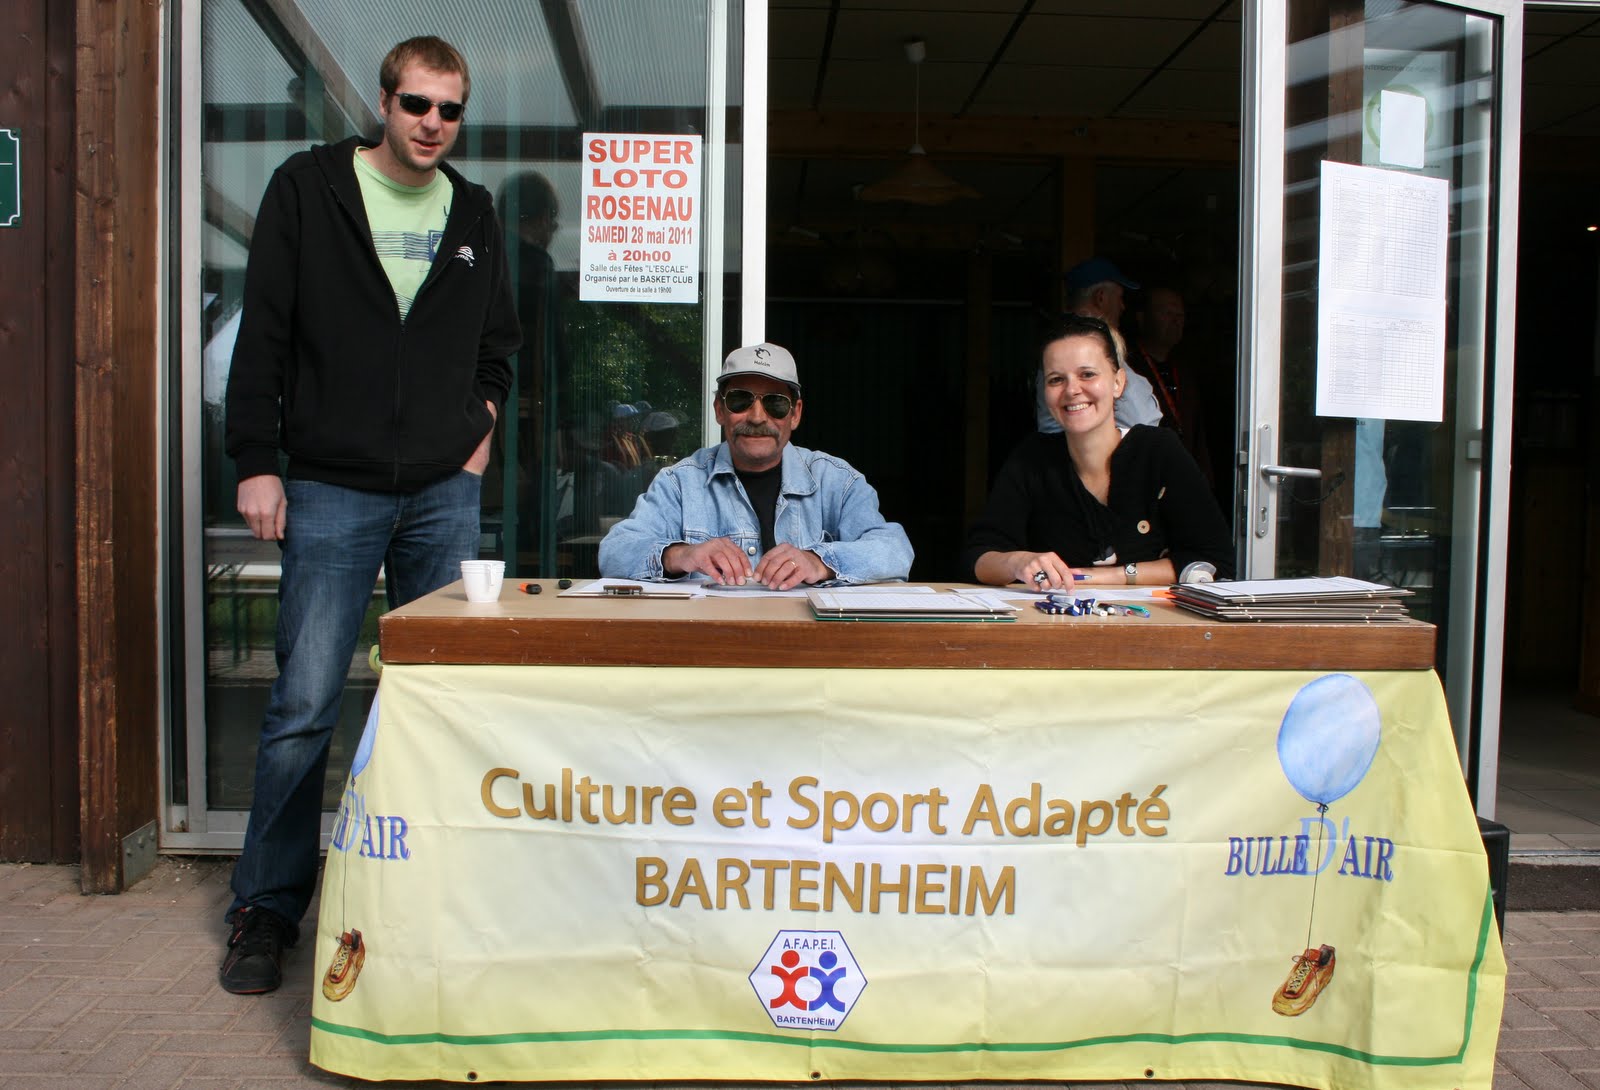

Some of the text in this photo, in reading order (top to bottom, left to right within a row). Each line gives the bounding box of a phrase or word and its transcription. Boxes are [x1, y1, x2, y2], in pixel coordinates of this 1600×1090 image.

[588, 139, 694, 164] SUPER
[592, 168, 688, 189] LOTO
[587, 195, 692, 221] ROSENAU
[588, 226, 692, 245] SAMEDI 28 mai 2011
[608, 250, 672, 262] à 20h00
[590, 264, 607, 272] Salle
[624, 264, 643, 272] Fêtes
[585, 274, 617, 284] Organisé
[619, 276, 630, 284] par
[640, 275, 671, 284] BASKET
[672, 276, 693, 284] CLUB
[481, 768, 1170, 848] Culture et Sport Adapté
[1225, 834, 1310, 877] BULLE
[635, 857, 1016, 916] BARTENHEIM
[783, 939, 836, 950] A.F.A.P.E.I.
[776, 1015, 836, 1026] BARTENHEIM
